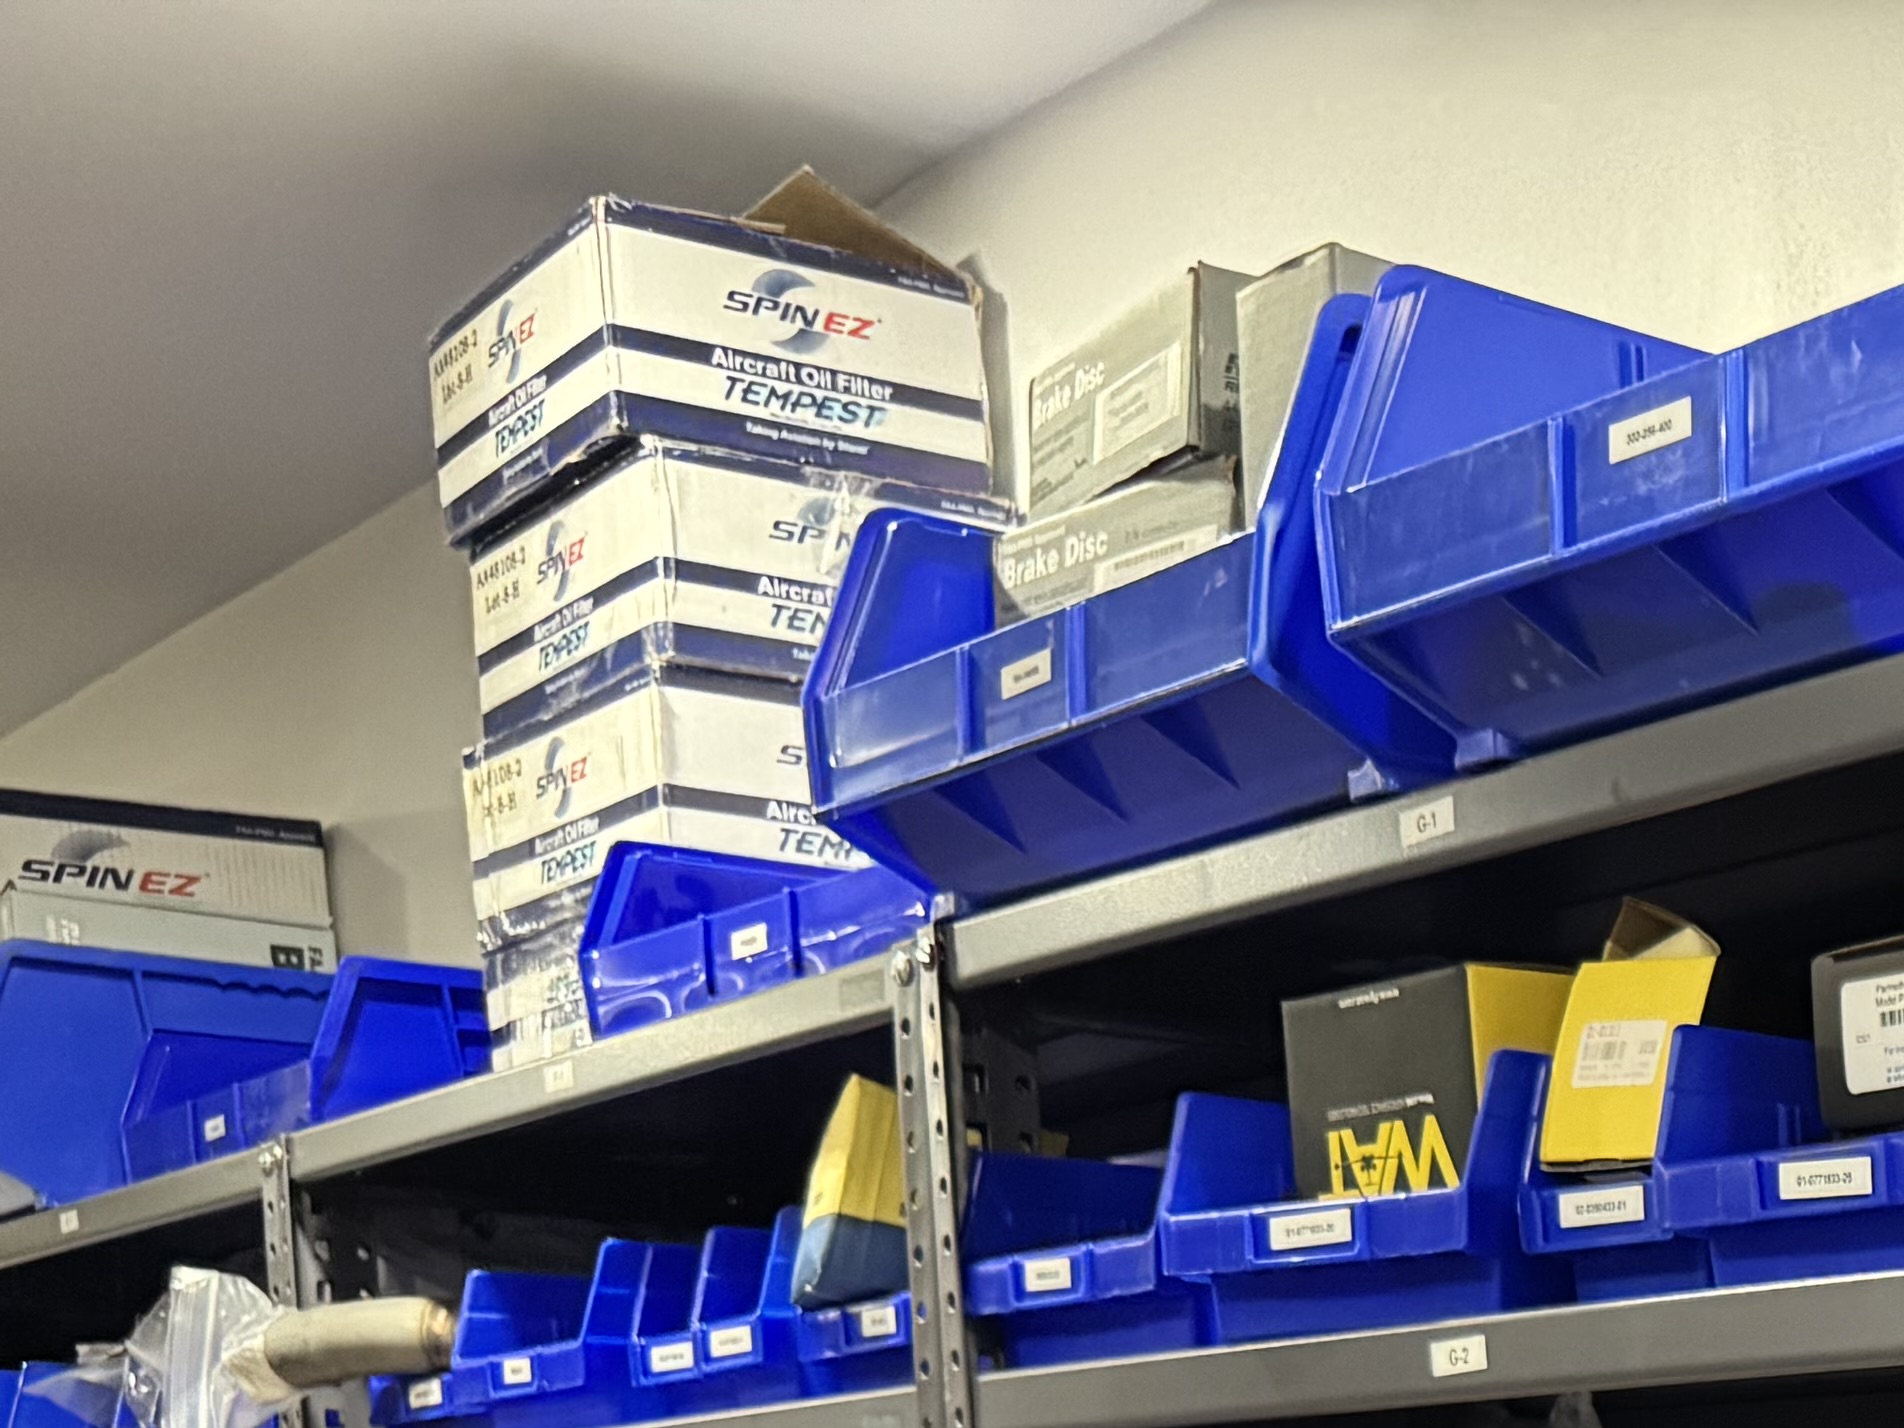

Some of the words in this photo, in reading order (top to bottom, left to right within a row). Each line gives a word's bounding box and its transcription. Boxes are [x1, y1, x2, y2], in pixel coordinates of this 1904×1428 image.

[712, 347, 796, 383] Aircraft
[801, 365, 832, 389] Oil
[836, 373, 894, 401] Filter
[1074, 362, 1105, 396] Disc
[722, 376, 888, 429] TEMPEST
[1003, 546, 1059, 590] Brake
[1064, 530, 1108, 568] Disc
[1416, 811, 1438, 835] G-1
[1449, 1348, 1470, 1366] G-2
